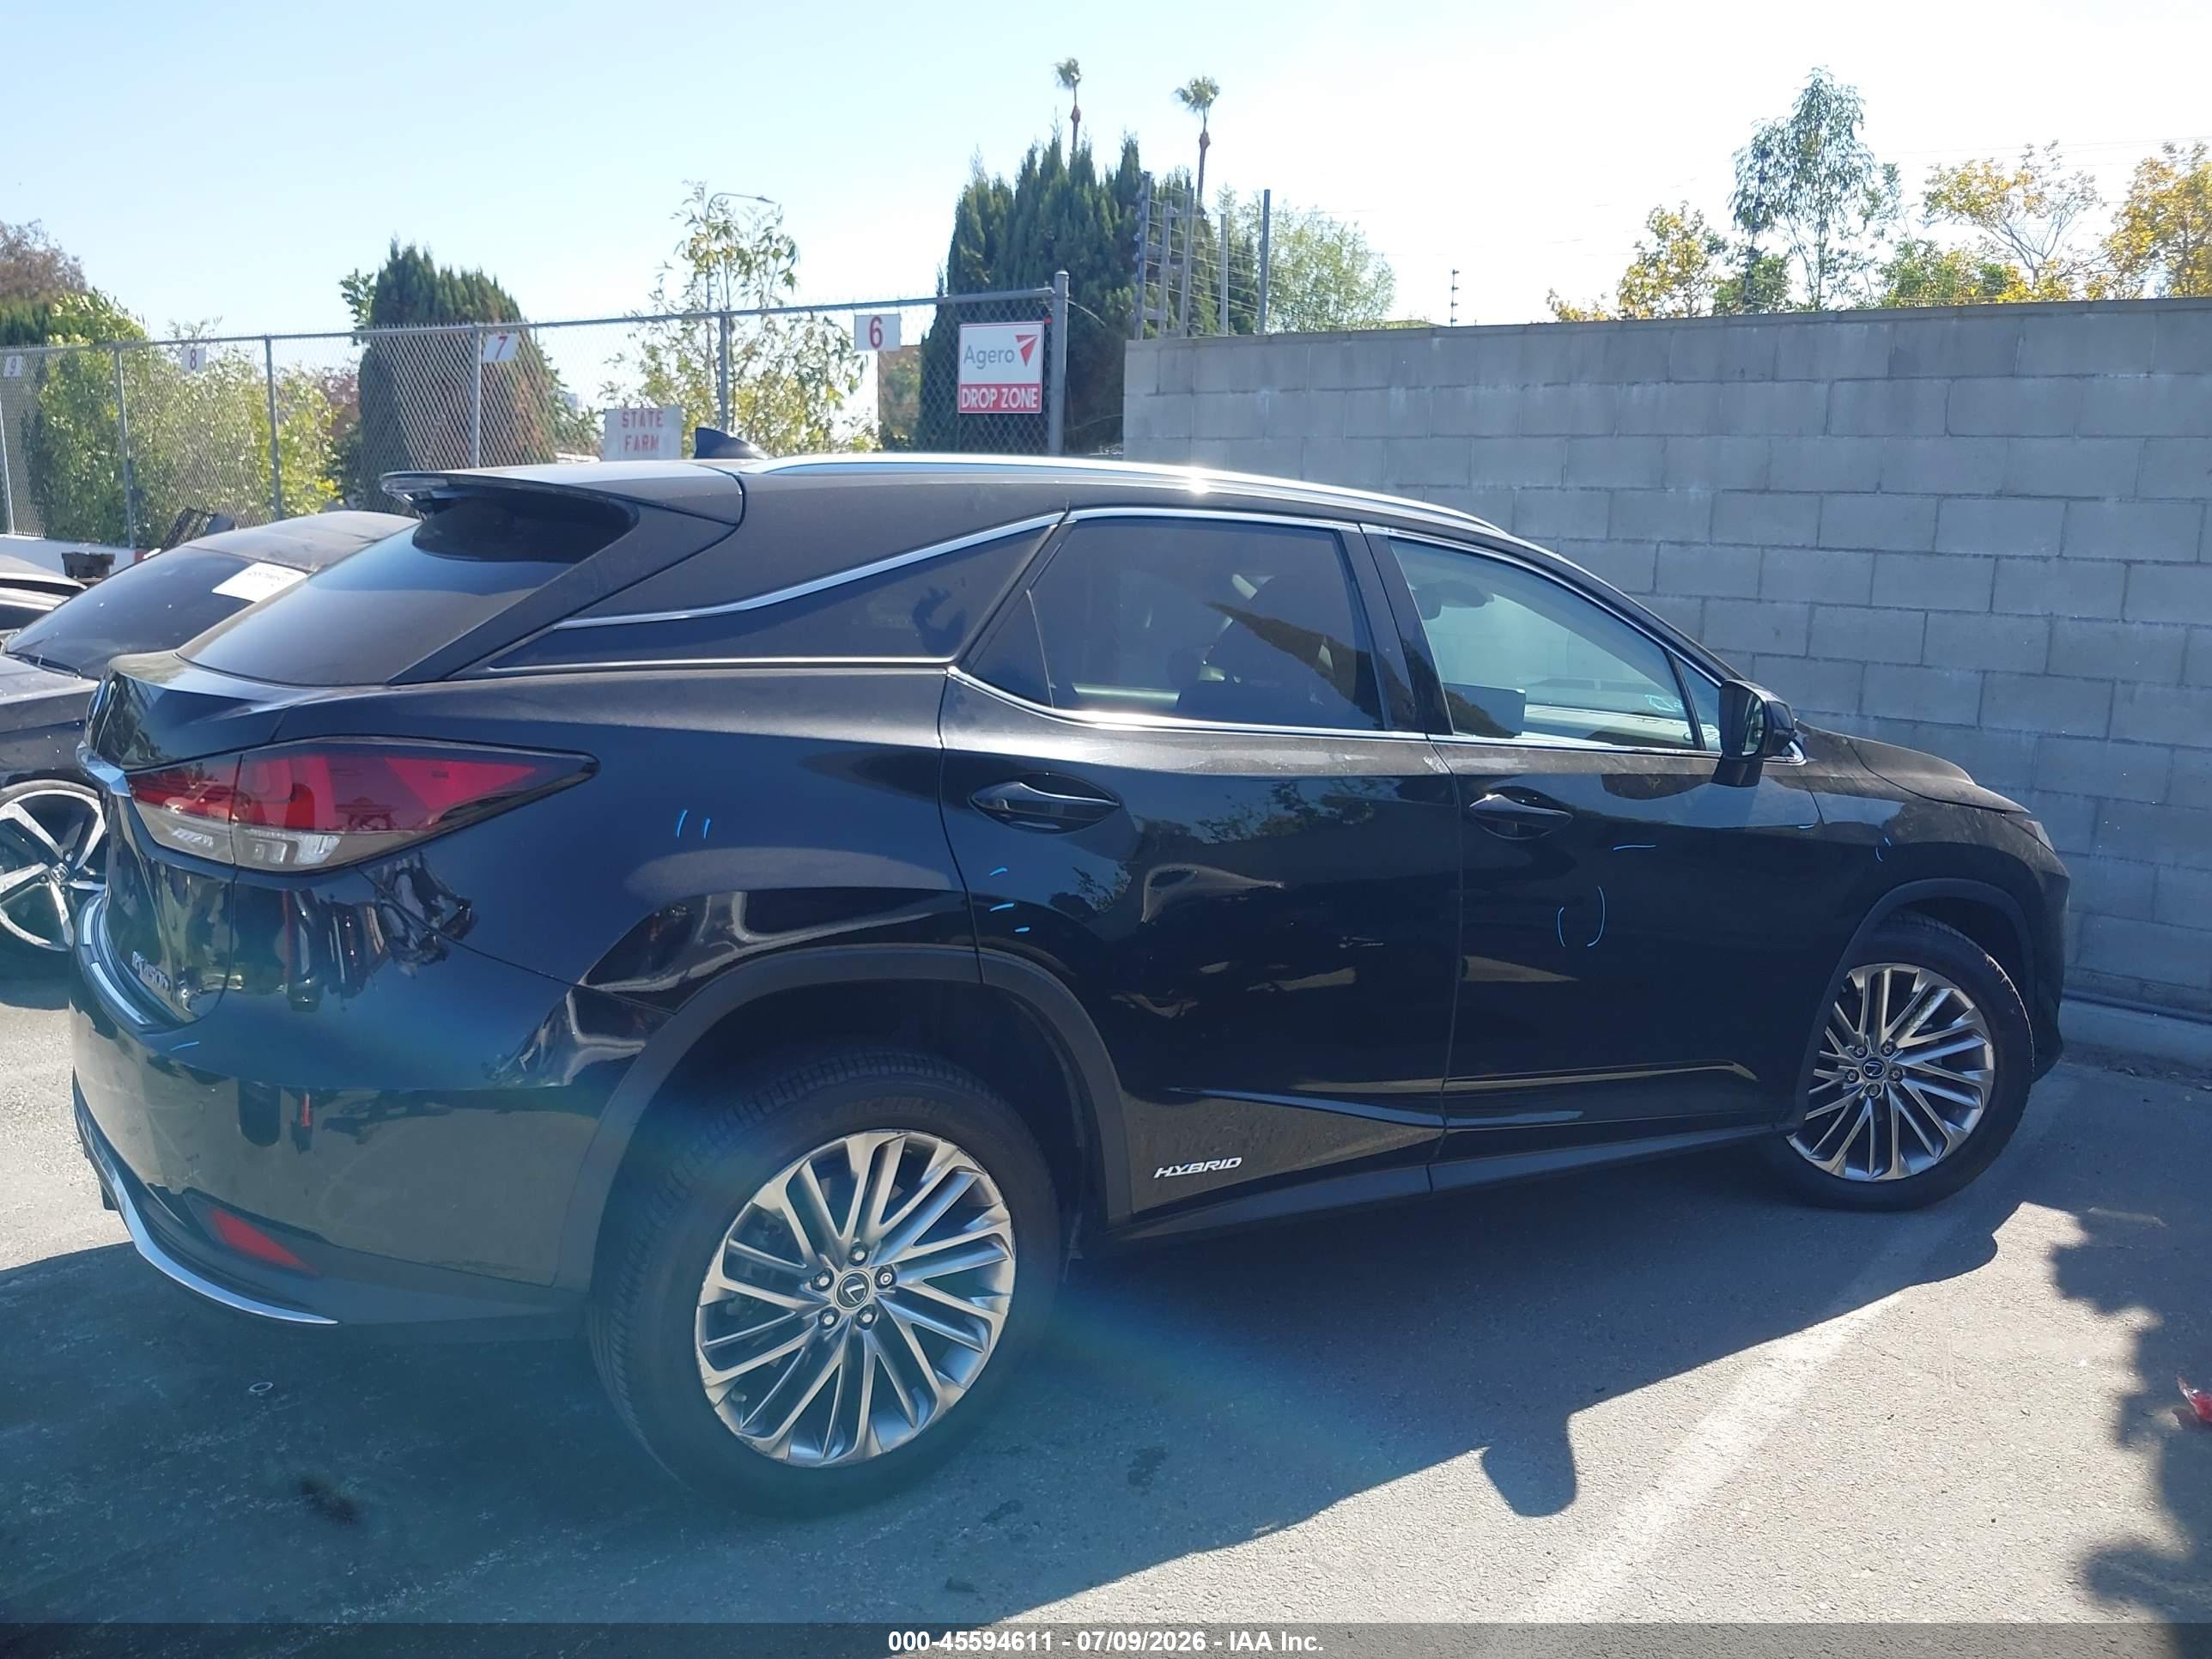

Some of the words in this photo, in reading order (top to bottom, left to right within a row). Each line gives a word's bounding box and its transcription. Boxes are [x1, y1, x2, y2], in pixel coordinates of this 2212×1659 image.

[870, 316, 883, 349] 6
[190, 349, 198, 370] 8
[495, 336, 508, 361] 7
[963, 344, 1015, 370] Agero
[9, 356, 17, 376] 9
[962, 387, 997, 409] DROP
[1001, 387, 1038, 409] ZONE
[622, 410, 664, 428] STATE
[625, 434, 660, 453] FARM
[1153, 1157, 1243, 1179] HYBRID
